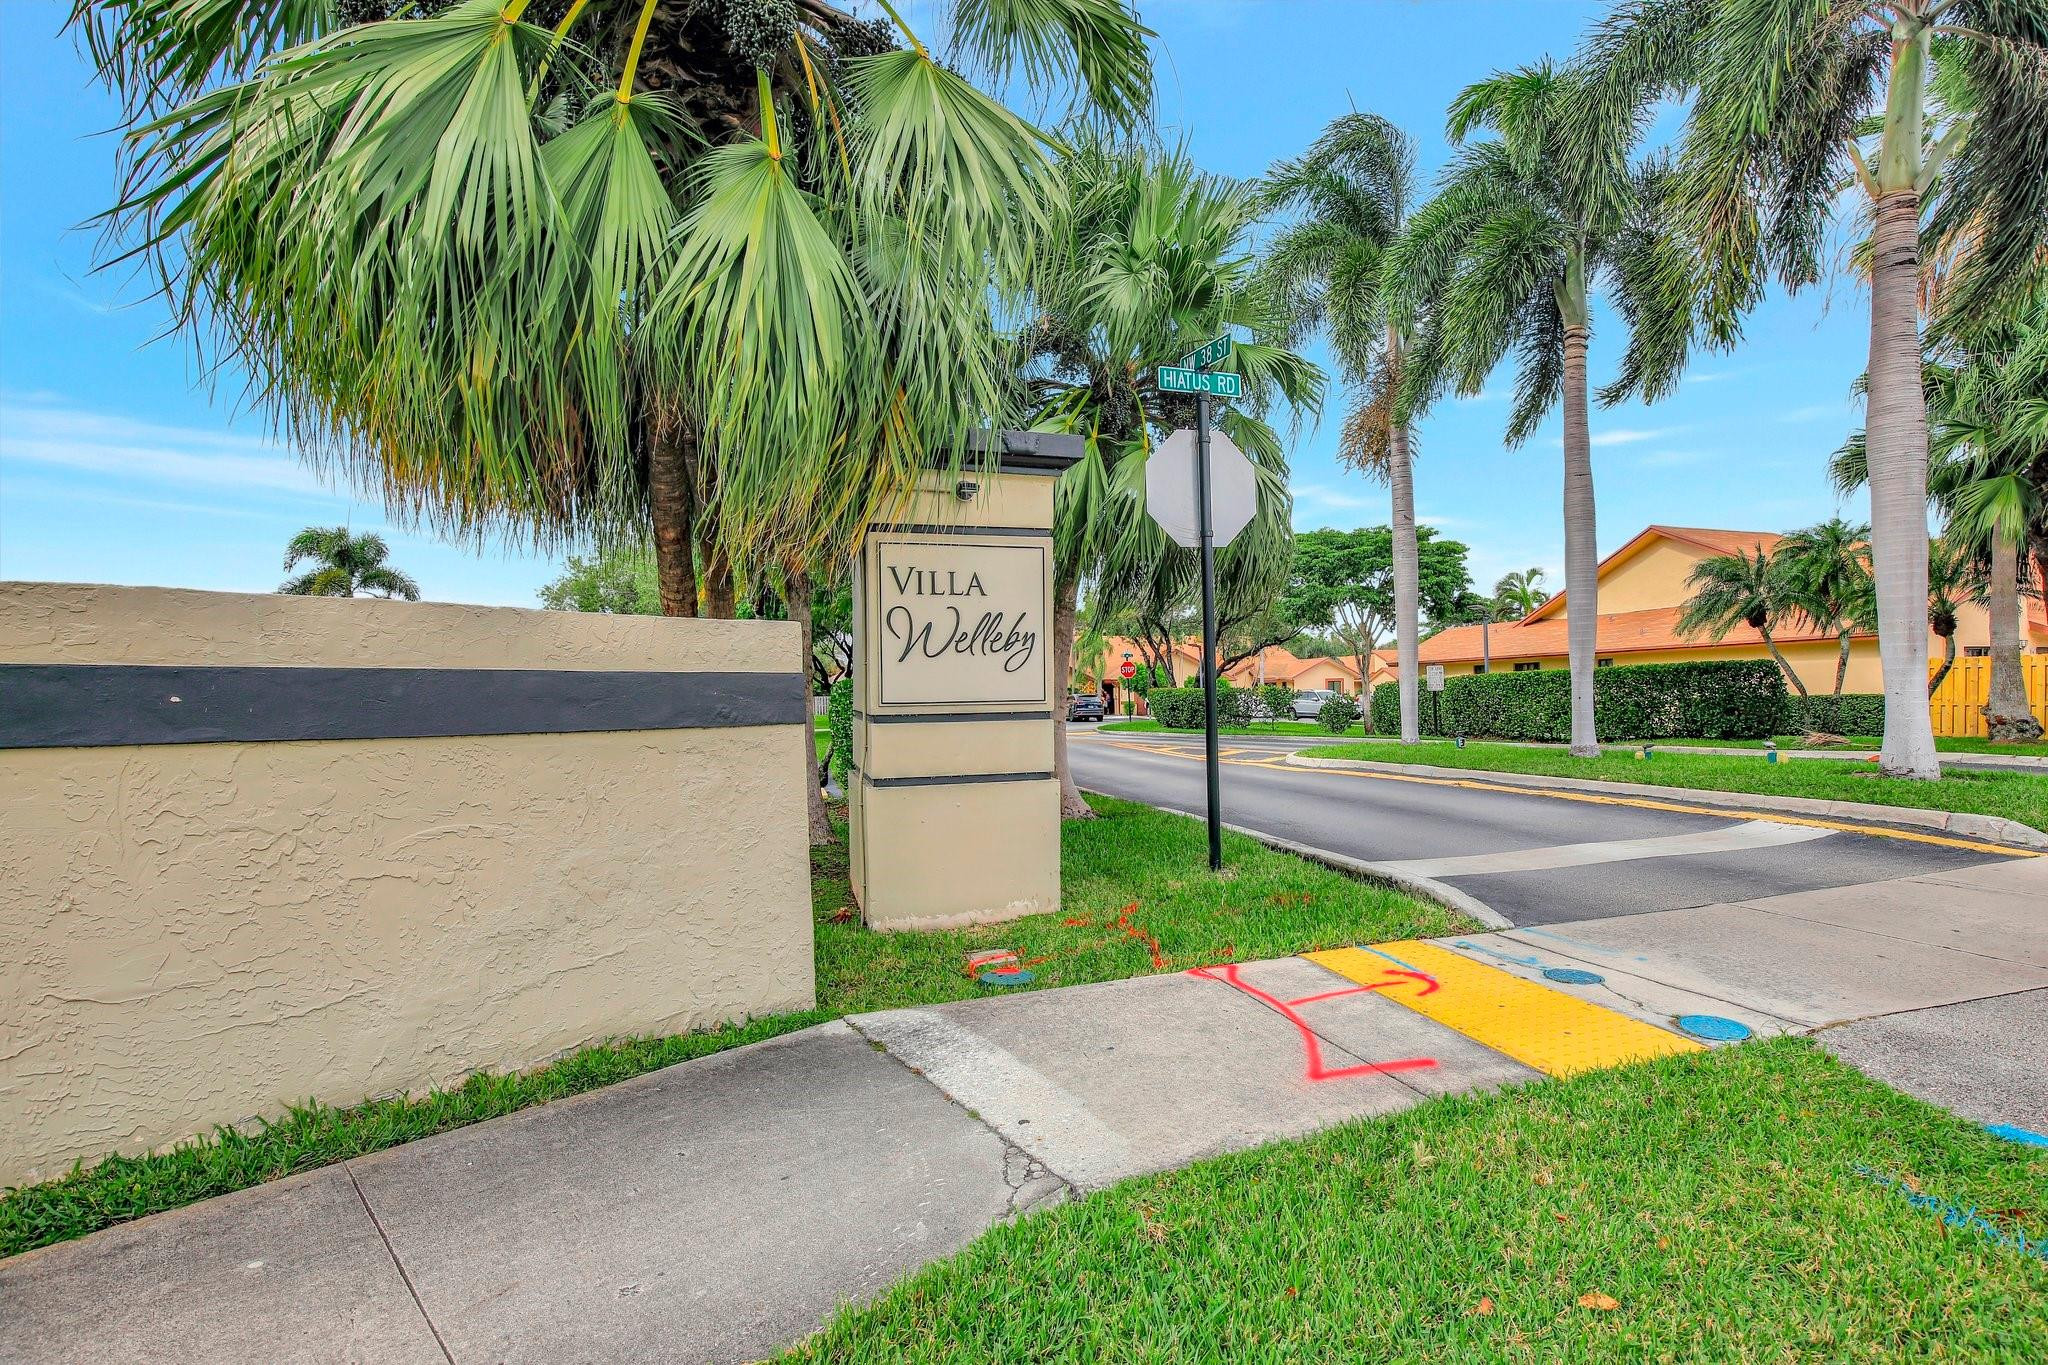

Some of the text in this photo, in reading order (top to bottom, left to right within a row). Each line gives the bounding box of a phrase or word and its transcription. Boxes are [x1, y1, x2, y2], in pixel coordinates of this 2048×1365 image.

[1183, 337, 1228, 370] NW 38 ST
[1163, 370, 1236, 394] HIATUS RD
[887, 566, 988, 597] VILLA
[886, 605, 1036, 673] Welleby
